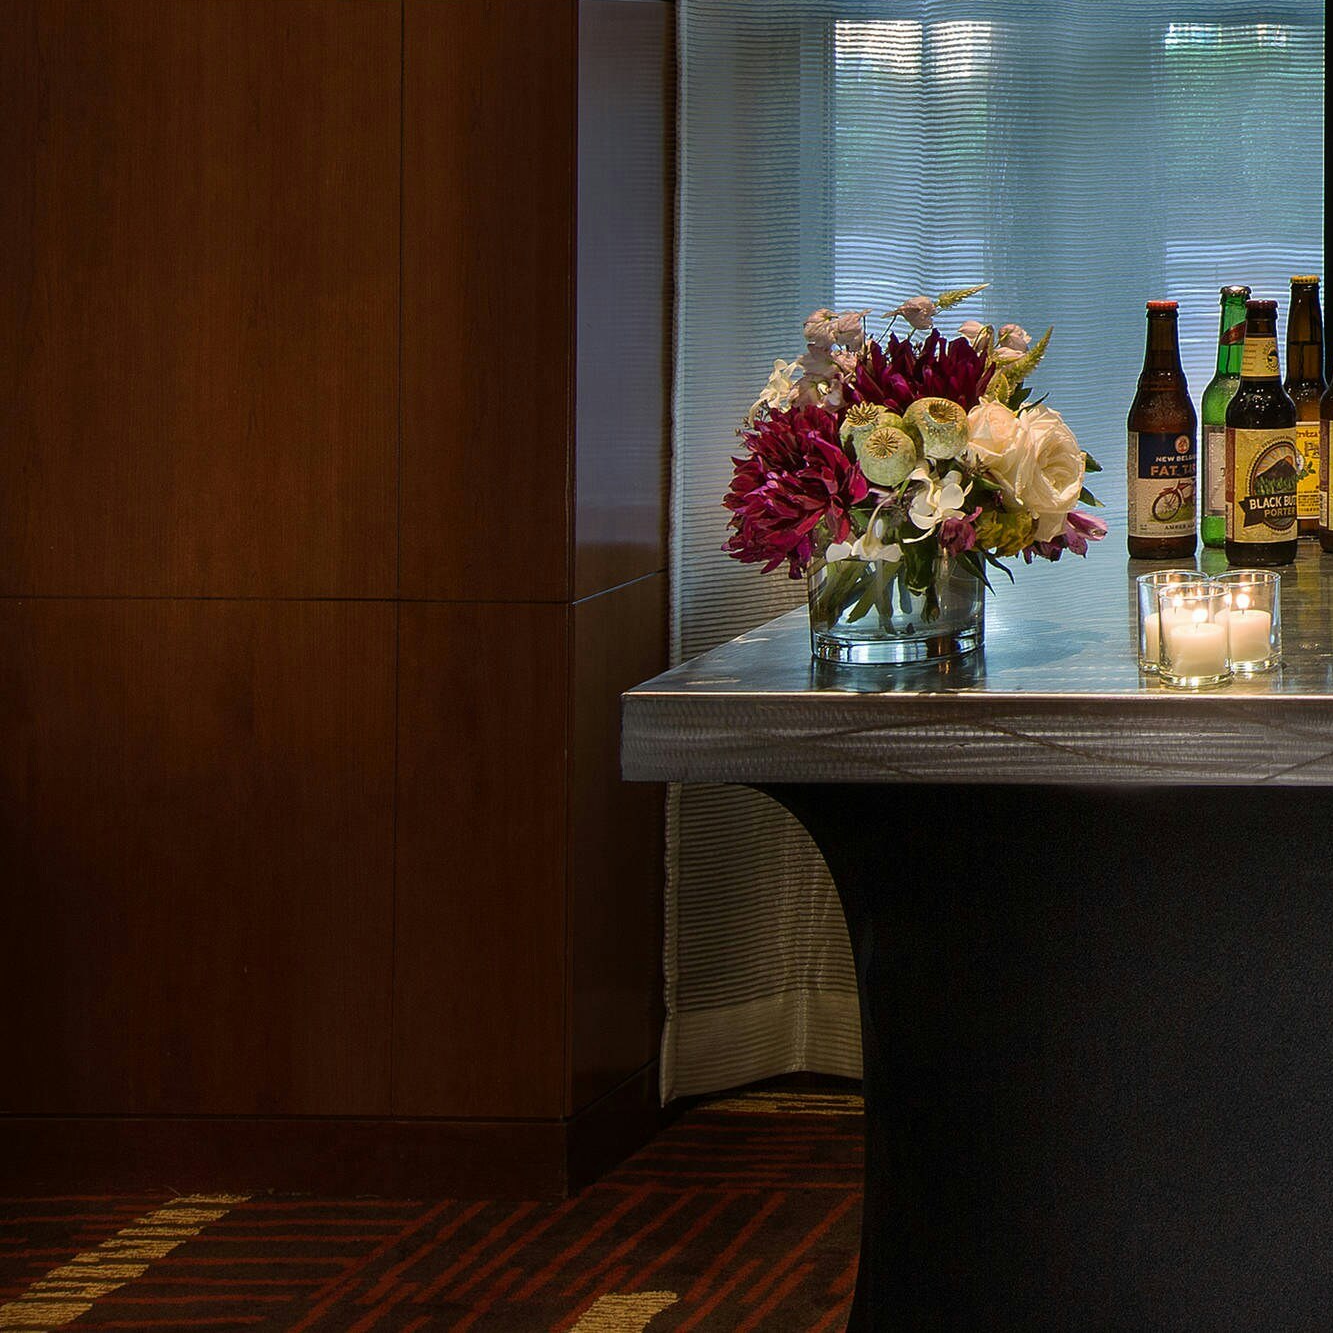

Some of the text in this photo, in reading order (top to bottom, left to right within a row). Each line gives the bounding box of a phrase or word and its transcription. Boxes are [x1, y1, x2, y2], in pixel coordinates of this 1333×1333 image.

[1155, 455, 1175, 463] NEW
[1151, 464, 1178, 476] FAT
[1249, 496, 1282, 510] BLACK
[1283, 495, 1297, 507] BUT
